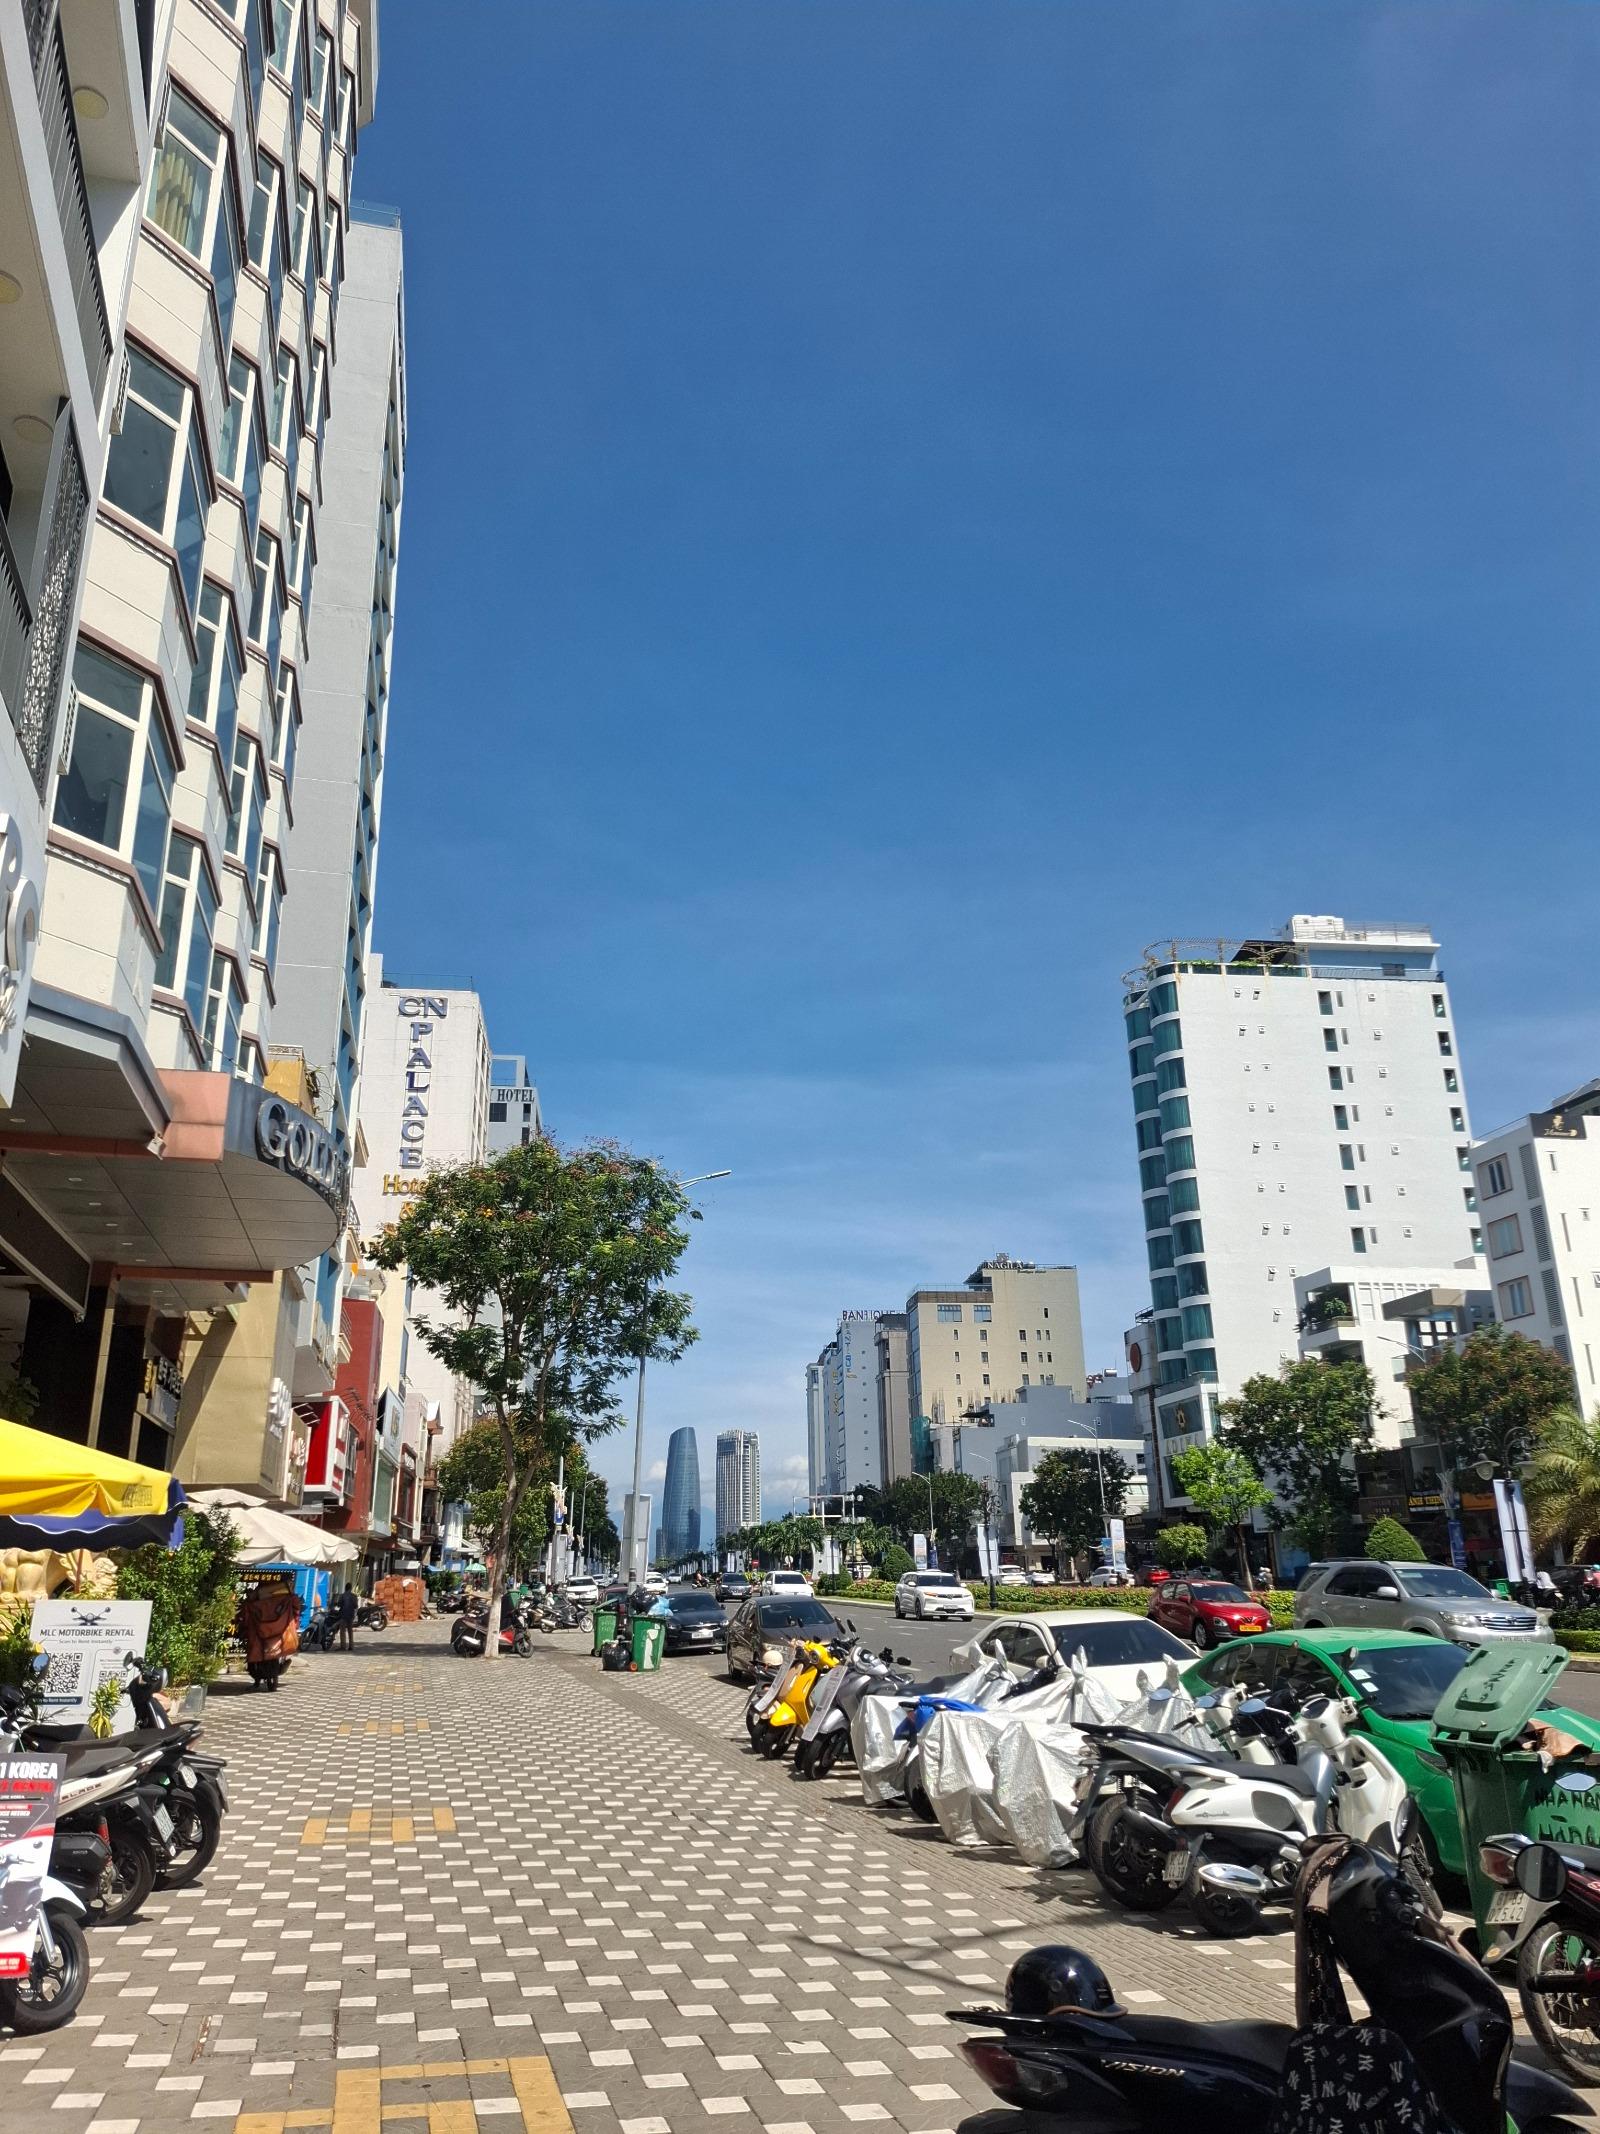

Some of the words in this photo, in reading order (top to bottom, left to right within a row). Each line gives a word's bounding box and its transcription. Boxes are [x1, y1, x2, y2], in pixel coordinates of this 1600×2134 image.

[398, 996, 449, 1018] CN
[399, 1021, 434, 1169] PALACE
[497, 1088, 536, 1102] HOTEL
[383, 1173, 430, 1196] Hote
[40, 1628, 57, 1637] MLC
[58, 1628, 103, 1637] MOTORBIKE
[105, 1628, 136, 1637] RENTAL
[9, 1761, 58, 1780] KOREA
